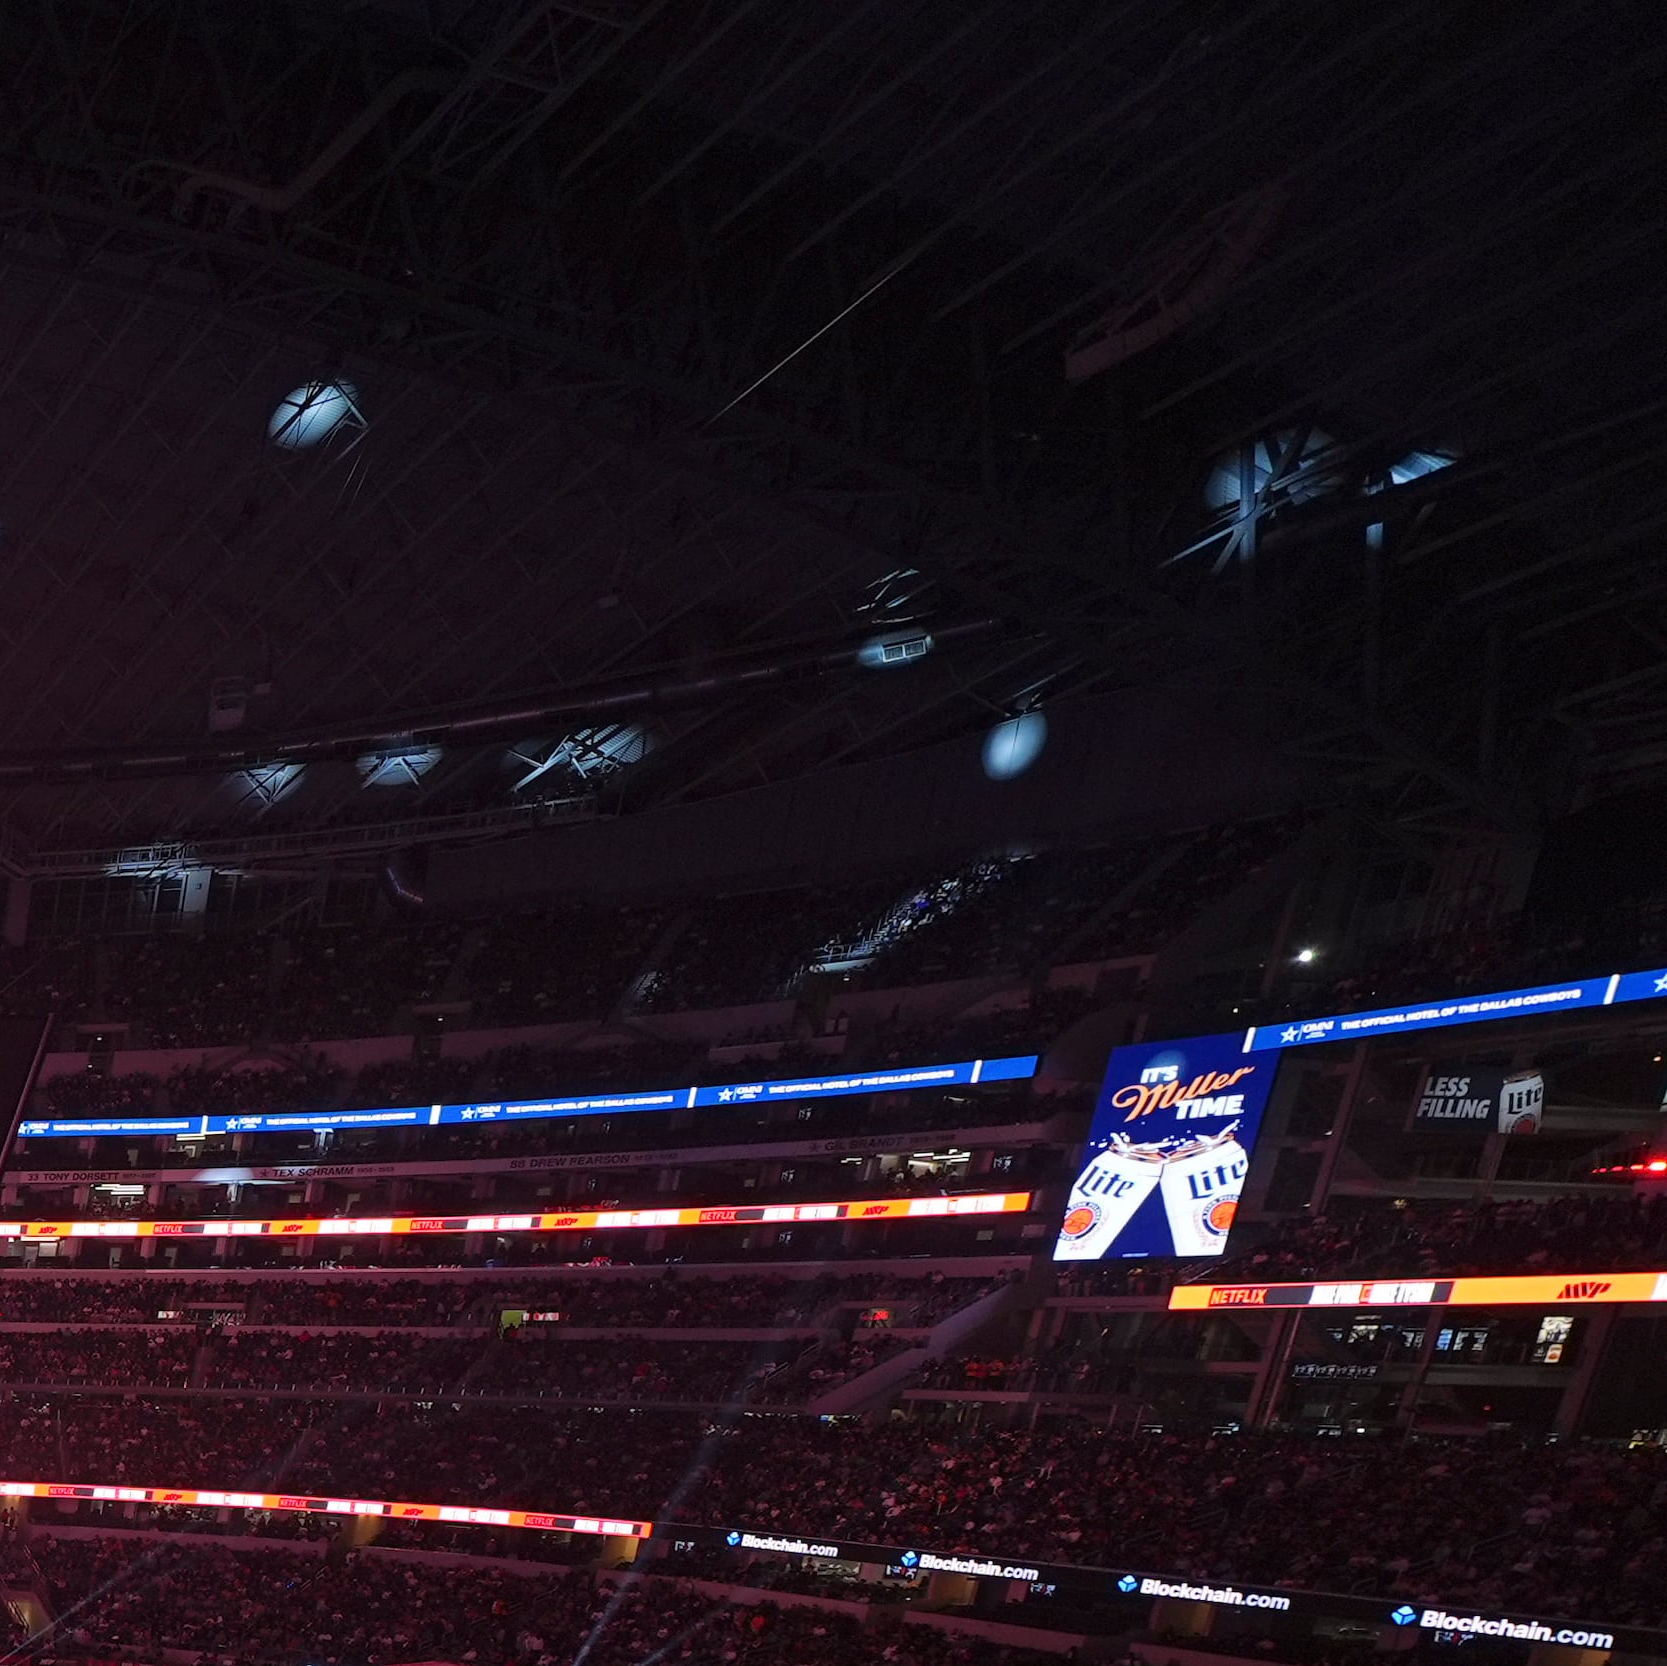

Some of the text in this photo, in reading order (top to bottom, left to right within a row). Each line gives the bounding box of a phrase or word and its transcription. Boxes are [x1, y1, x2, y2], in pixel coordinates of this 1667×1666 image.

[1342, 989, 1581, 1029] THE OFFICIAL HOTEL OF THE DALLAS COWBOYS
[1302, 1021, 1334, 1033] OMNI
[786, 1084, 821, 1092] OFFICIAL
[823, 1081, 848, 1089] HOTEL
[850, 1079, 861, 1087] OF
[863, 1077, 878, 1085] THE
[879, 1074, 911, 1084] DALLAS
[911, 1070, 954, 1081] COWBOYS
[1141, 1066, 1179, 1084] IT'S
[1112, 1066, 1255, 1122] Miller
[1424, 1077, 1471, 1096] LESS
[1417, 1099, 1491, 1119] FILLING
[1508, 1086, 1543, 1114] Lite
[849, 1136, 905, 1150] BRANDT
[529, 1158, 565, 1168] DREW
[569, 1154, 630, 1167] PEARSON
[28, 1174, 39, 1182] 33
[43, 1173, 69, 1182] TONY
[72, 1172, 119, 1181] DORSETT
[273, 1168, 295, 1178] TEX
[298, 1166, 354, 1176] SCHRAMM
[1188, 1160, 1245, 1200] Lite
[1077, 1165, 1135, 1198] Lite
[411, 1220, 443, 1230] NETFLIX
[699, 1210, 737, 1222] NETFLIX
[154, 1224, 183, 1234] NETFLIX
[1210, 1288, 1267, 1305] NETFLIX
[49, 1486, 75, 1495] NETFLIX
[280, 1499, 306, 1508] NETFLIX
[526, 1516, 554, 1526] NETFLIX
[741, 1533, 838, 1559] Blockchain.com
[919, 1554, 1038, 1581] Blockchain.com
[1140, 1577, 1290, 1611] Blockchain.com
[1421, 1608, 1613, 1650] Blockchain.com
